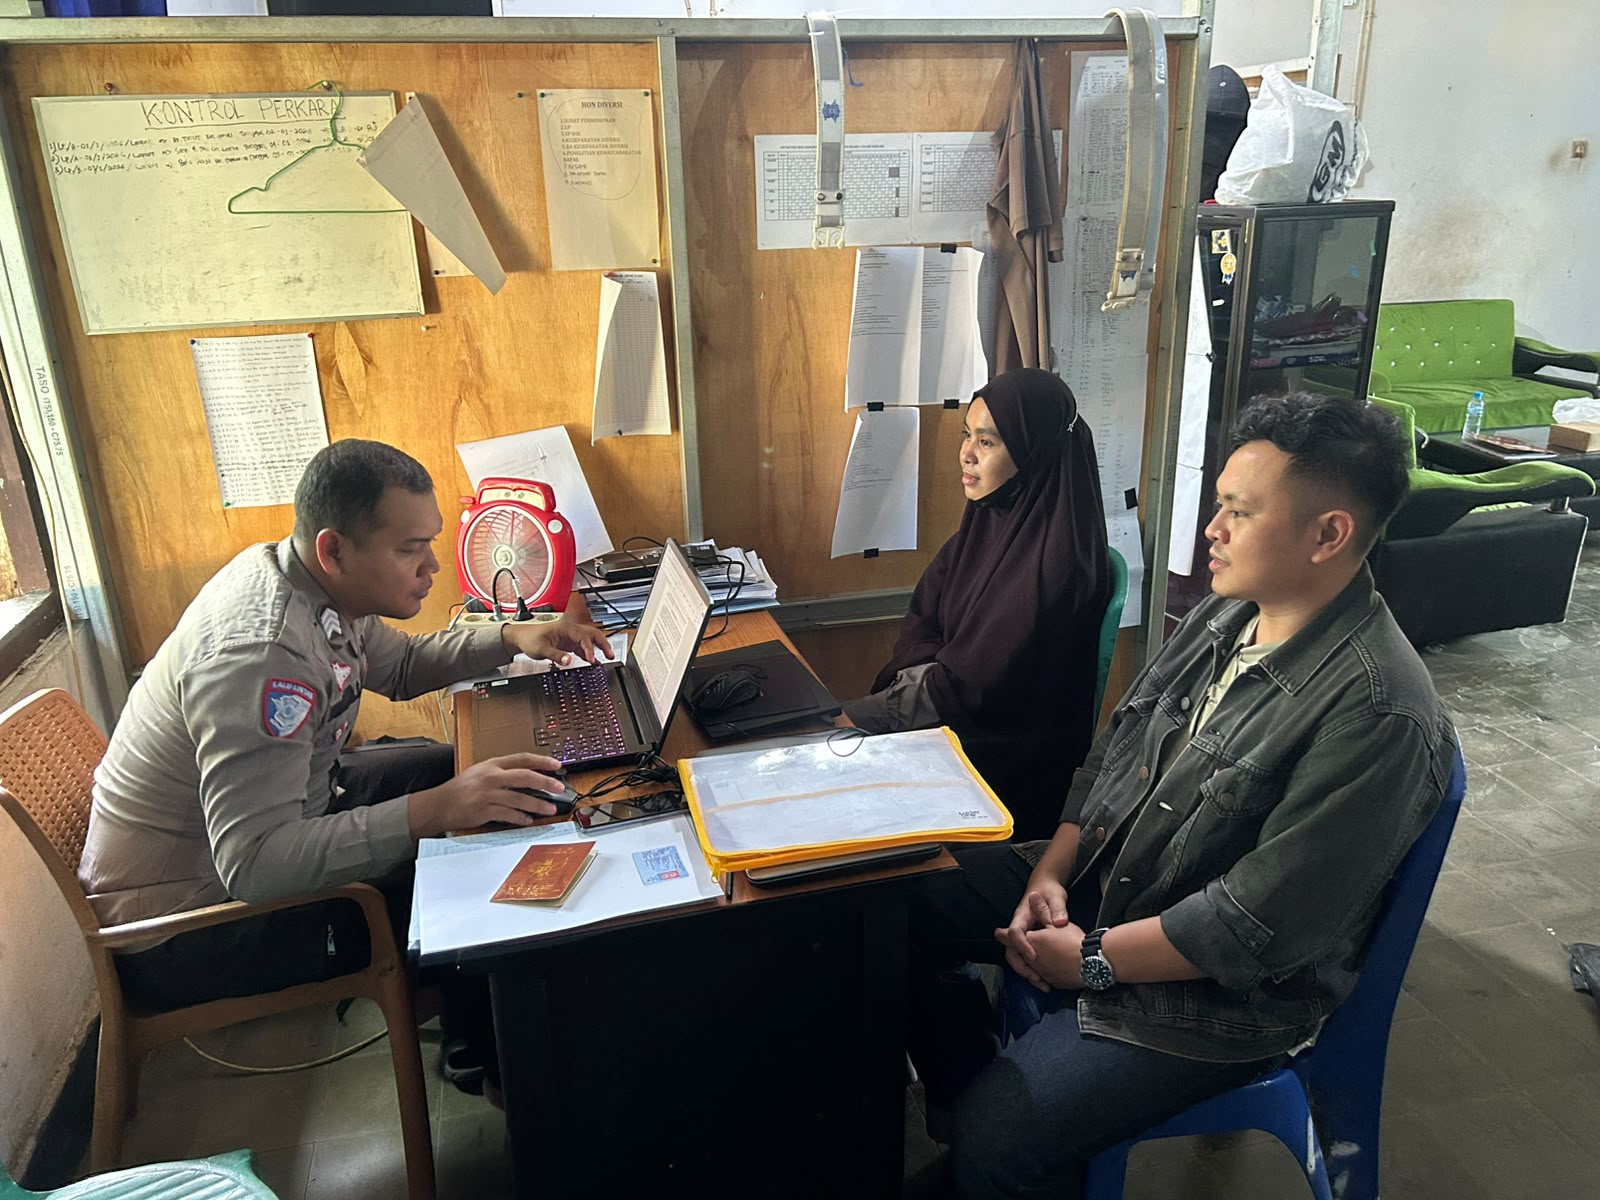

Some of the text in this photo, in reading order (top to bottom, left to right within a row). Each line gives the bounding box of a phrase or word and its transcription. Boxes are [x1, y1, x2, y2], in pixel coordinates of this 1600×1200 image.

[141, 98, 342, 126] KONTROL PERKARA
[597, 101, 624, 109] DIVERSI
[35, 366, 50, 394] TASO
